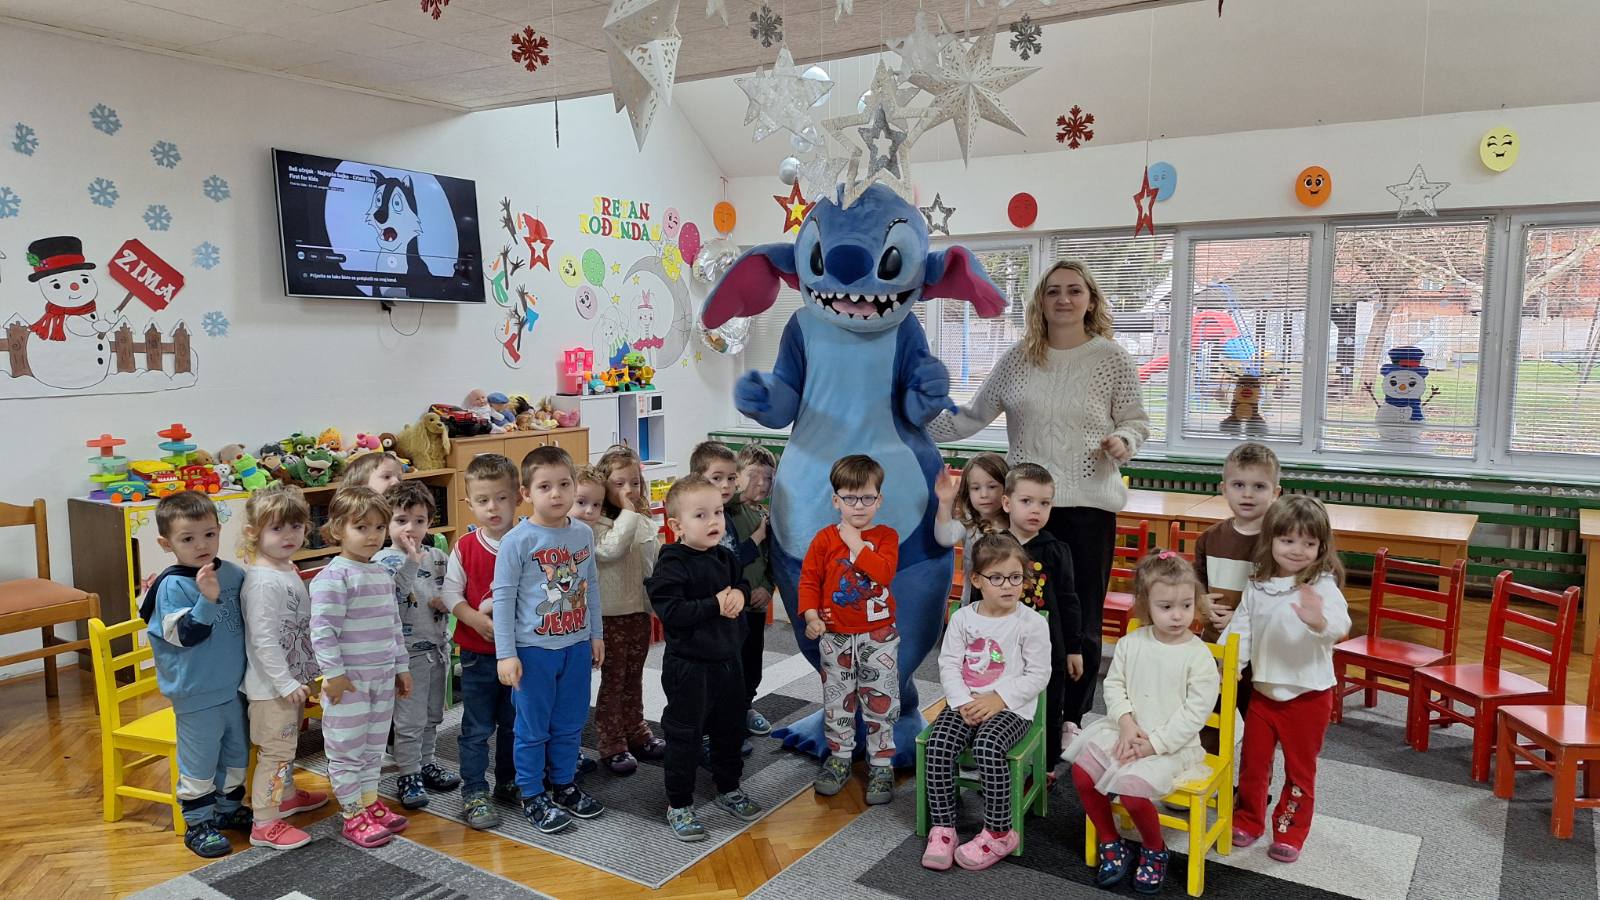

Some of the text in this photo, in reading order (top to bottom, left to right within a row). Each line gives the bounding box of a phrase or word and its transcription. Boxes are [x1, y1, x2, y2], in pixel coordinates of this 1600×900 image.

[592, 195, 650, 221] SRETAN
[114, 249, 176, 304] ZIMA
[532, 546, 572, 566] TOM
